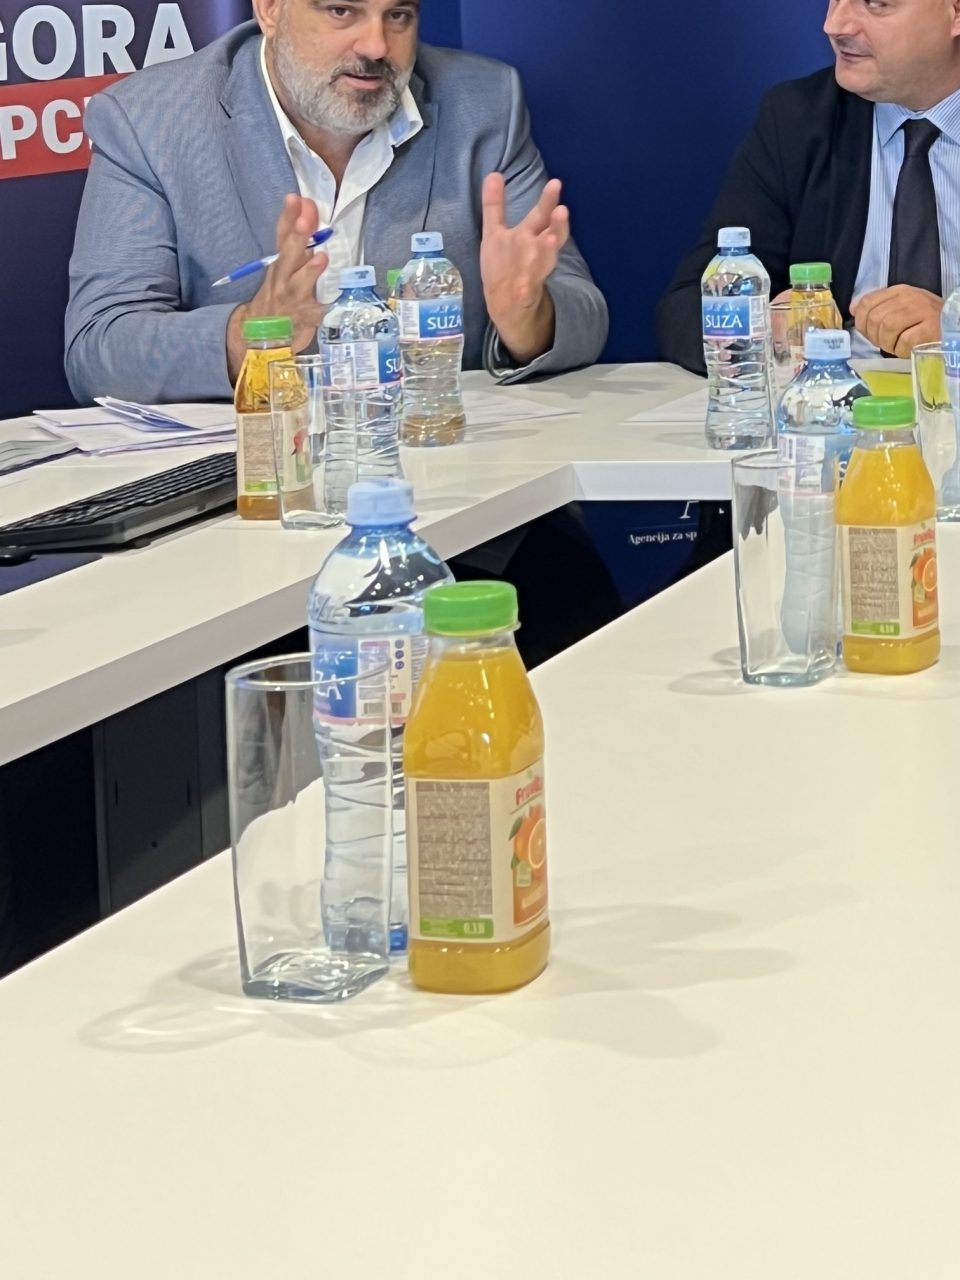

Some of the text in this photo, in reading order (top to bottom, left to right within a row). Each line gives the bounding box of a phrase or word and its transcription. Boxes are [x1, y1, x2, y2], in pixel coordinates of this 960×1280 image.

[0, 3, 195, 82] ORA
[427, 314, 462, 330] SUZA
[705, 314, 743, 329] SUZA
[629, 531, 670, 546] Agencija
[672, 532, 684, 540] za
